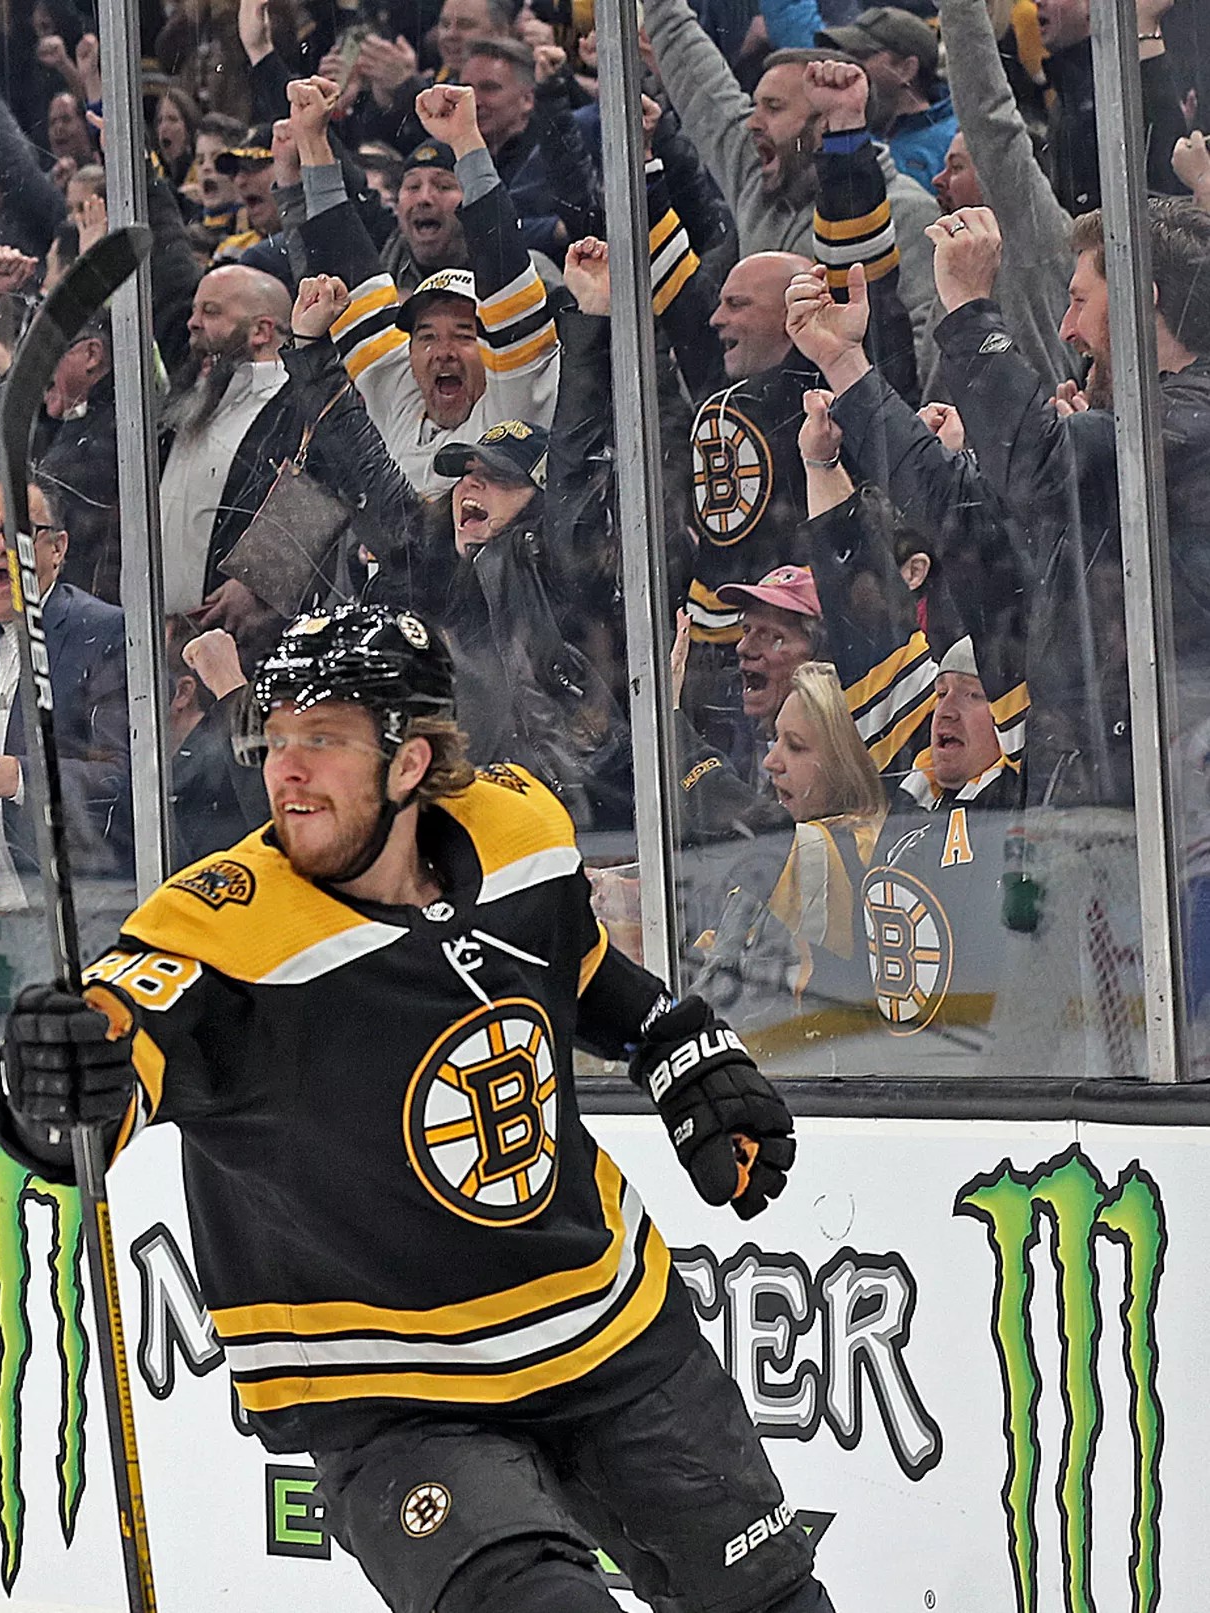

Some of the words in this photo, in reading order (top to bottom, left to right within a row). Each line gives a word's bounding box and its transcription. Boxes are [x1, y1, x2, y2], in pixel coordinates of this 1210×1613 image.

[16, 532, 54, 711] BAUER
[941, 806, 974, 869] A
[649, 1029, 749, 1103] BAUE
[458, 1044, 546, 1184] B
[725, 1500, 795, 1567] BAUE
